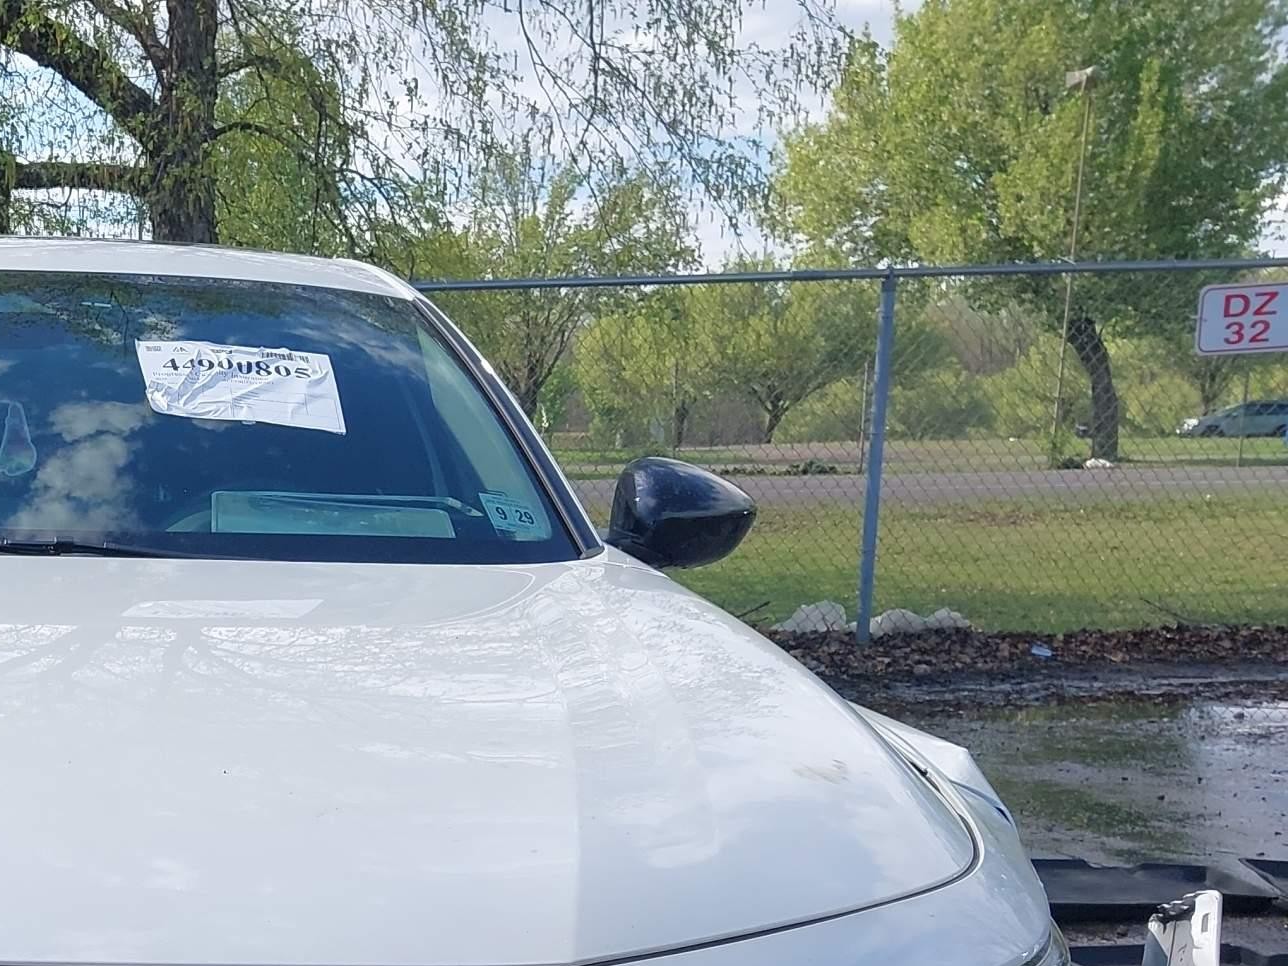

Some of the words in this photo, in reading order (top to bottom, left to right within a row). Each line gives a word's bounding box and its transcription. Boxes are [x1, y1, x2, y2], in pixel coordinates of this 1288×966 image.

[1223, 291, 1279, 318] DZ
[1223, 319, 1270, 345] 32
[495, 506, 508, 521] 9
[514, 509, 535, 525] 29
